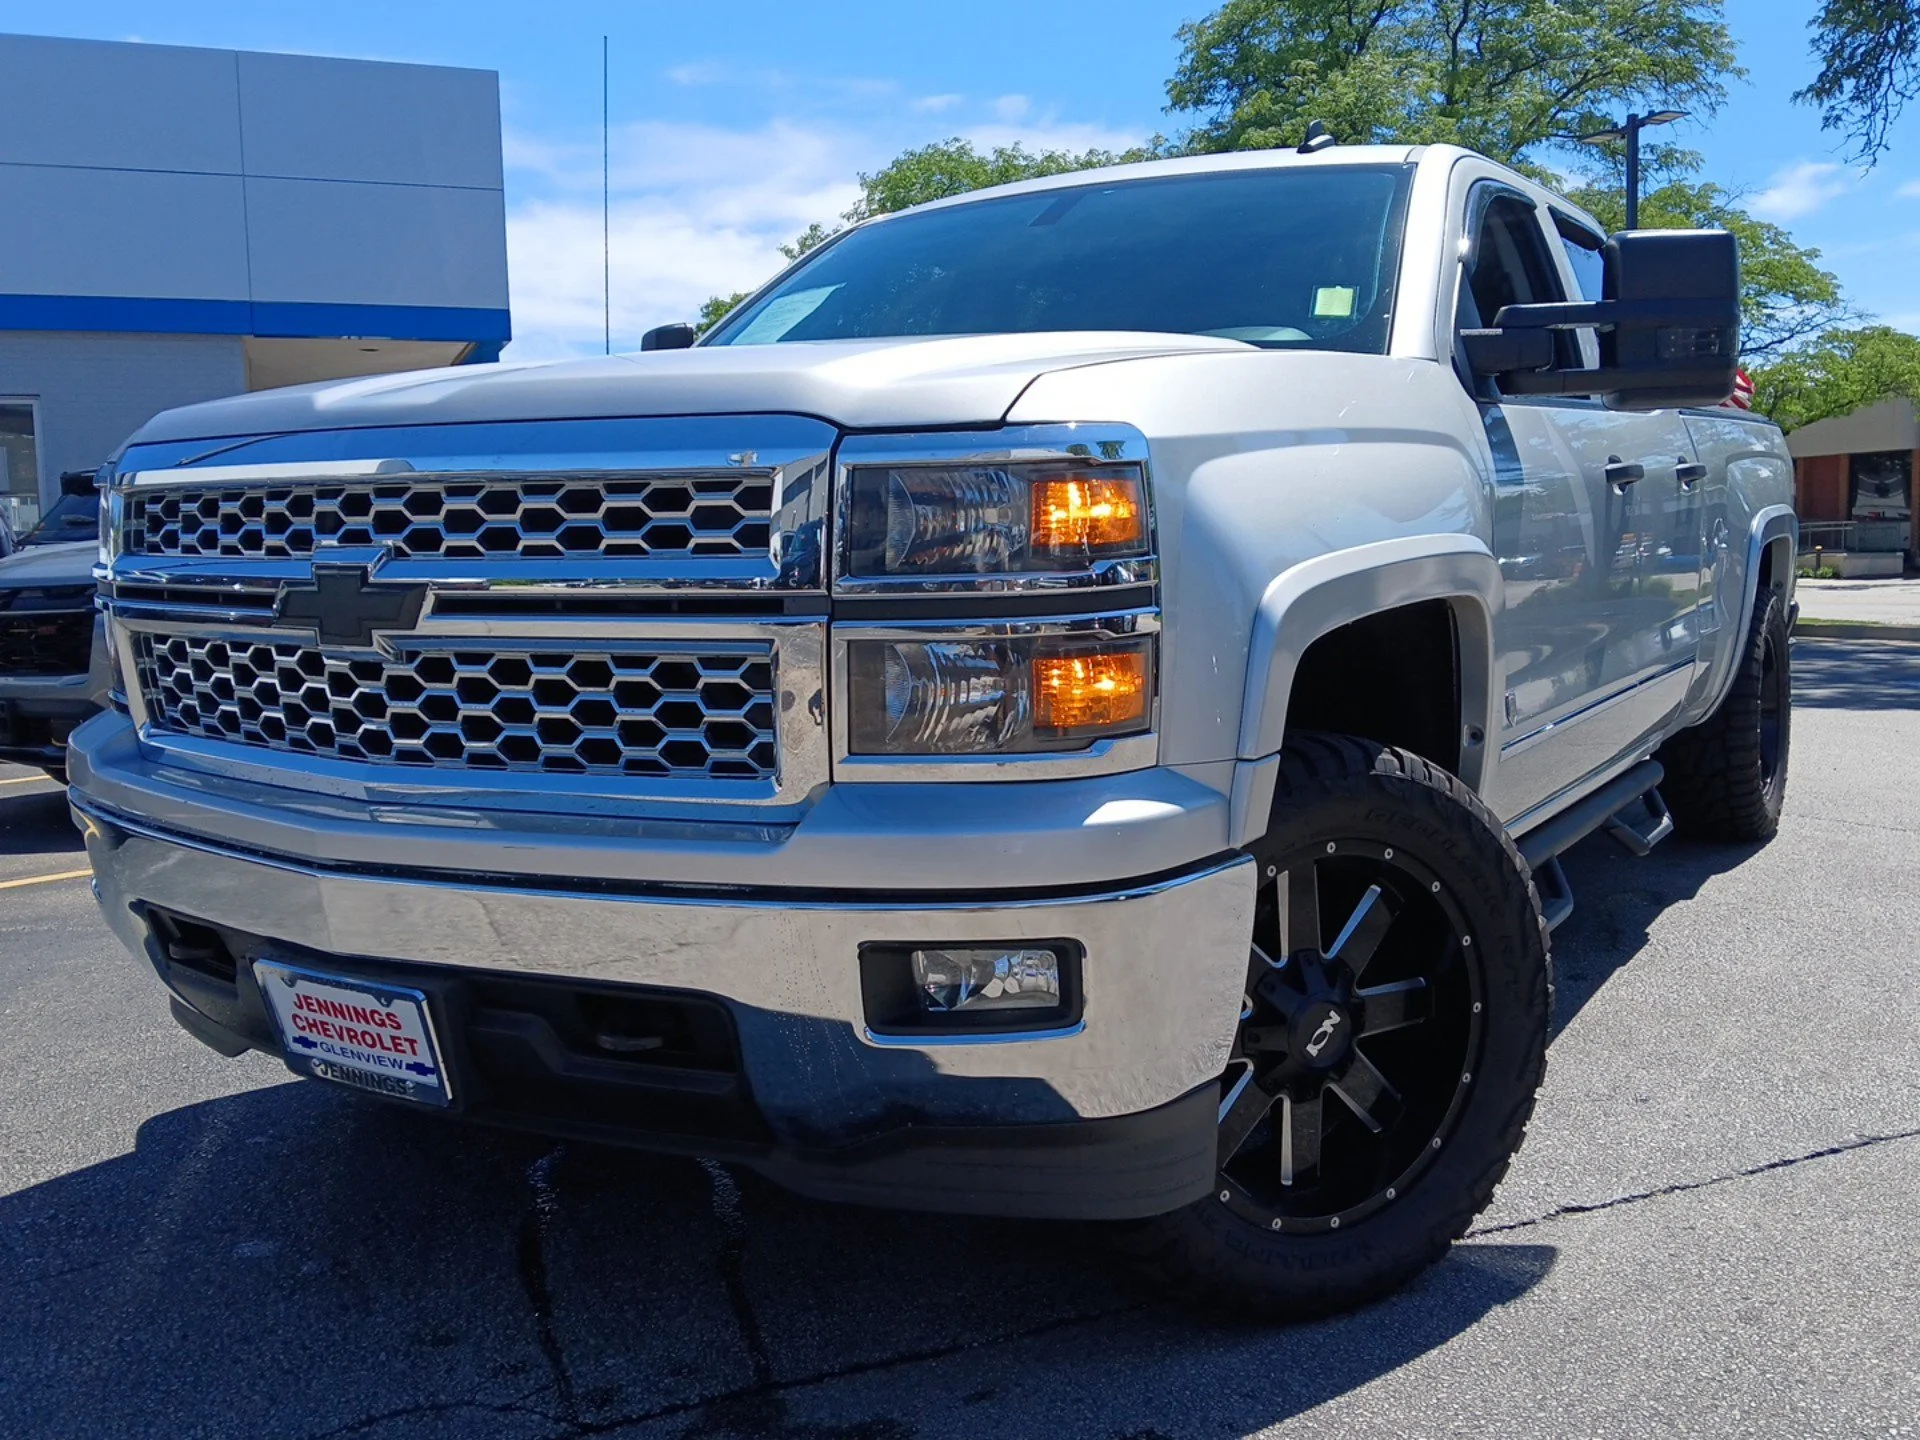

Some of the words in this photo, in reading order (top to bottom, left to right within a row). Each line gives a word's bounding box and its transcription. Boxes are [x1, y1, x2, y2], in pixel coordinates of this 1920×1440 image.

[293, 993, 402, 1030] JENNINGS
[291, 1013, 418, 1056] CHEVROLET
[319, 1041, 404, 1070] GLENVIEW
[319, 1064, 408, 1095] JENNINGS
